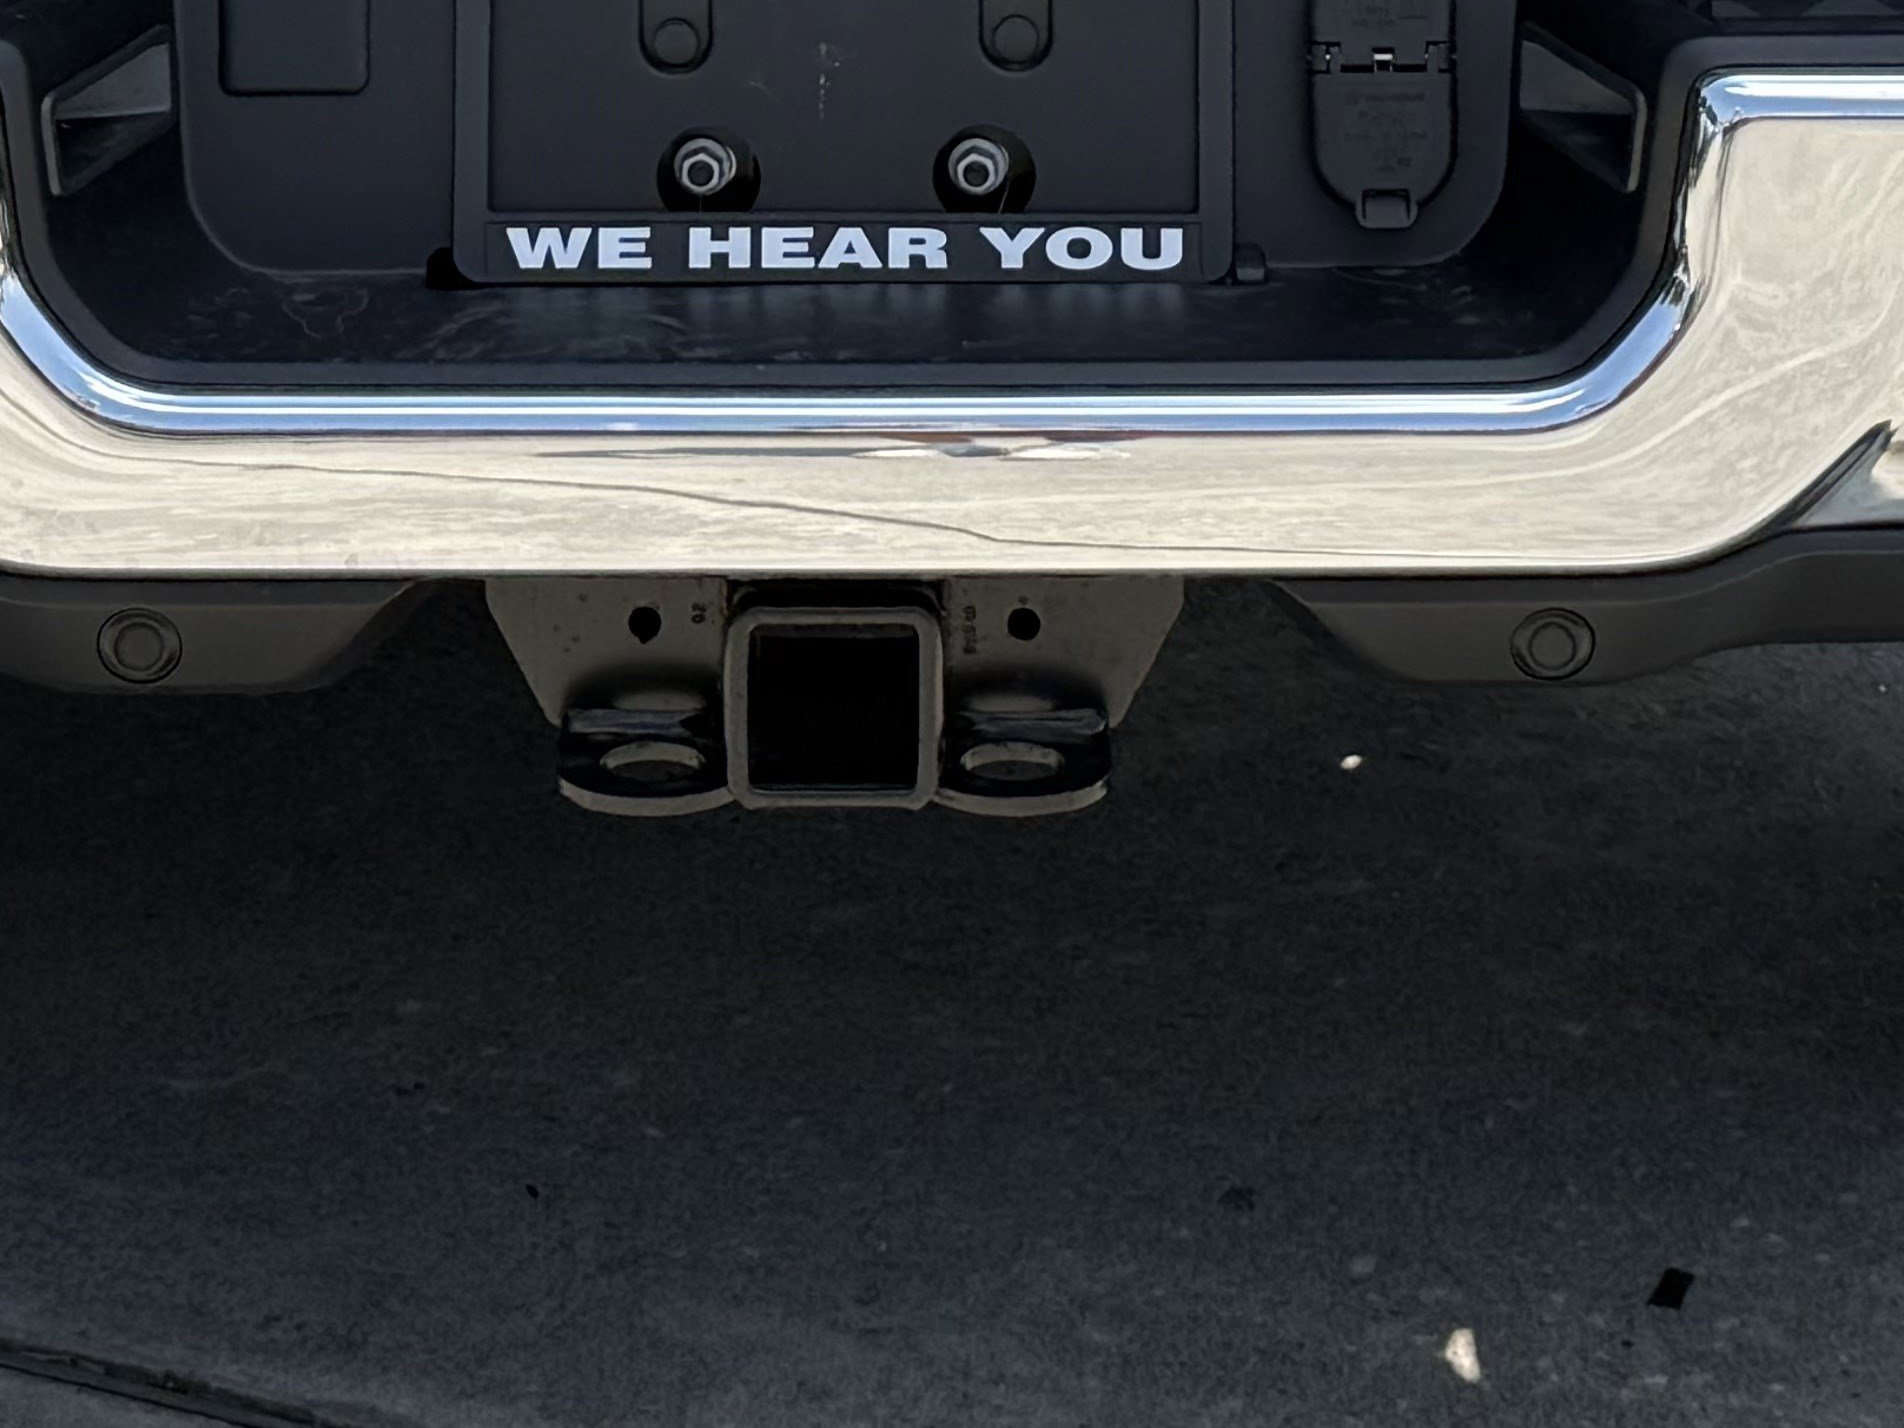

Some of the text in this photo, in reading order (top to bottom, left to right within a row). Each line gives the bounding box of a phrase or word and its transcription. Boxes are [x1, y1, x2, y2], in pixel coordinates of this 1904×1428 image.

[505, 225, 1185, 271] WE HEAR YOU
